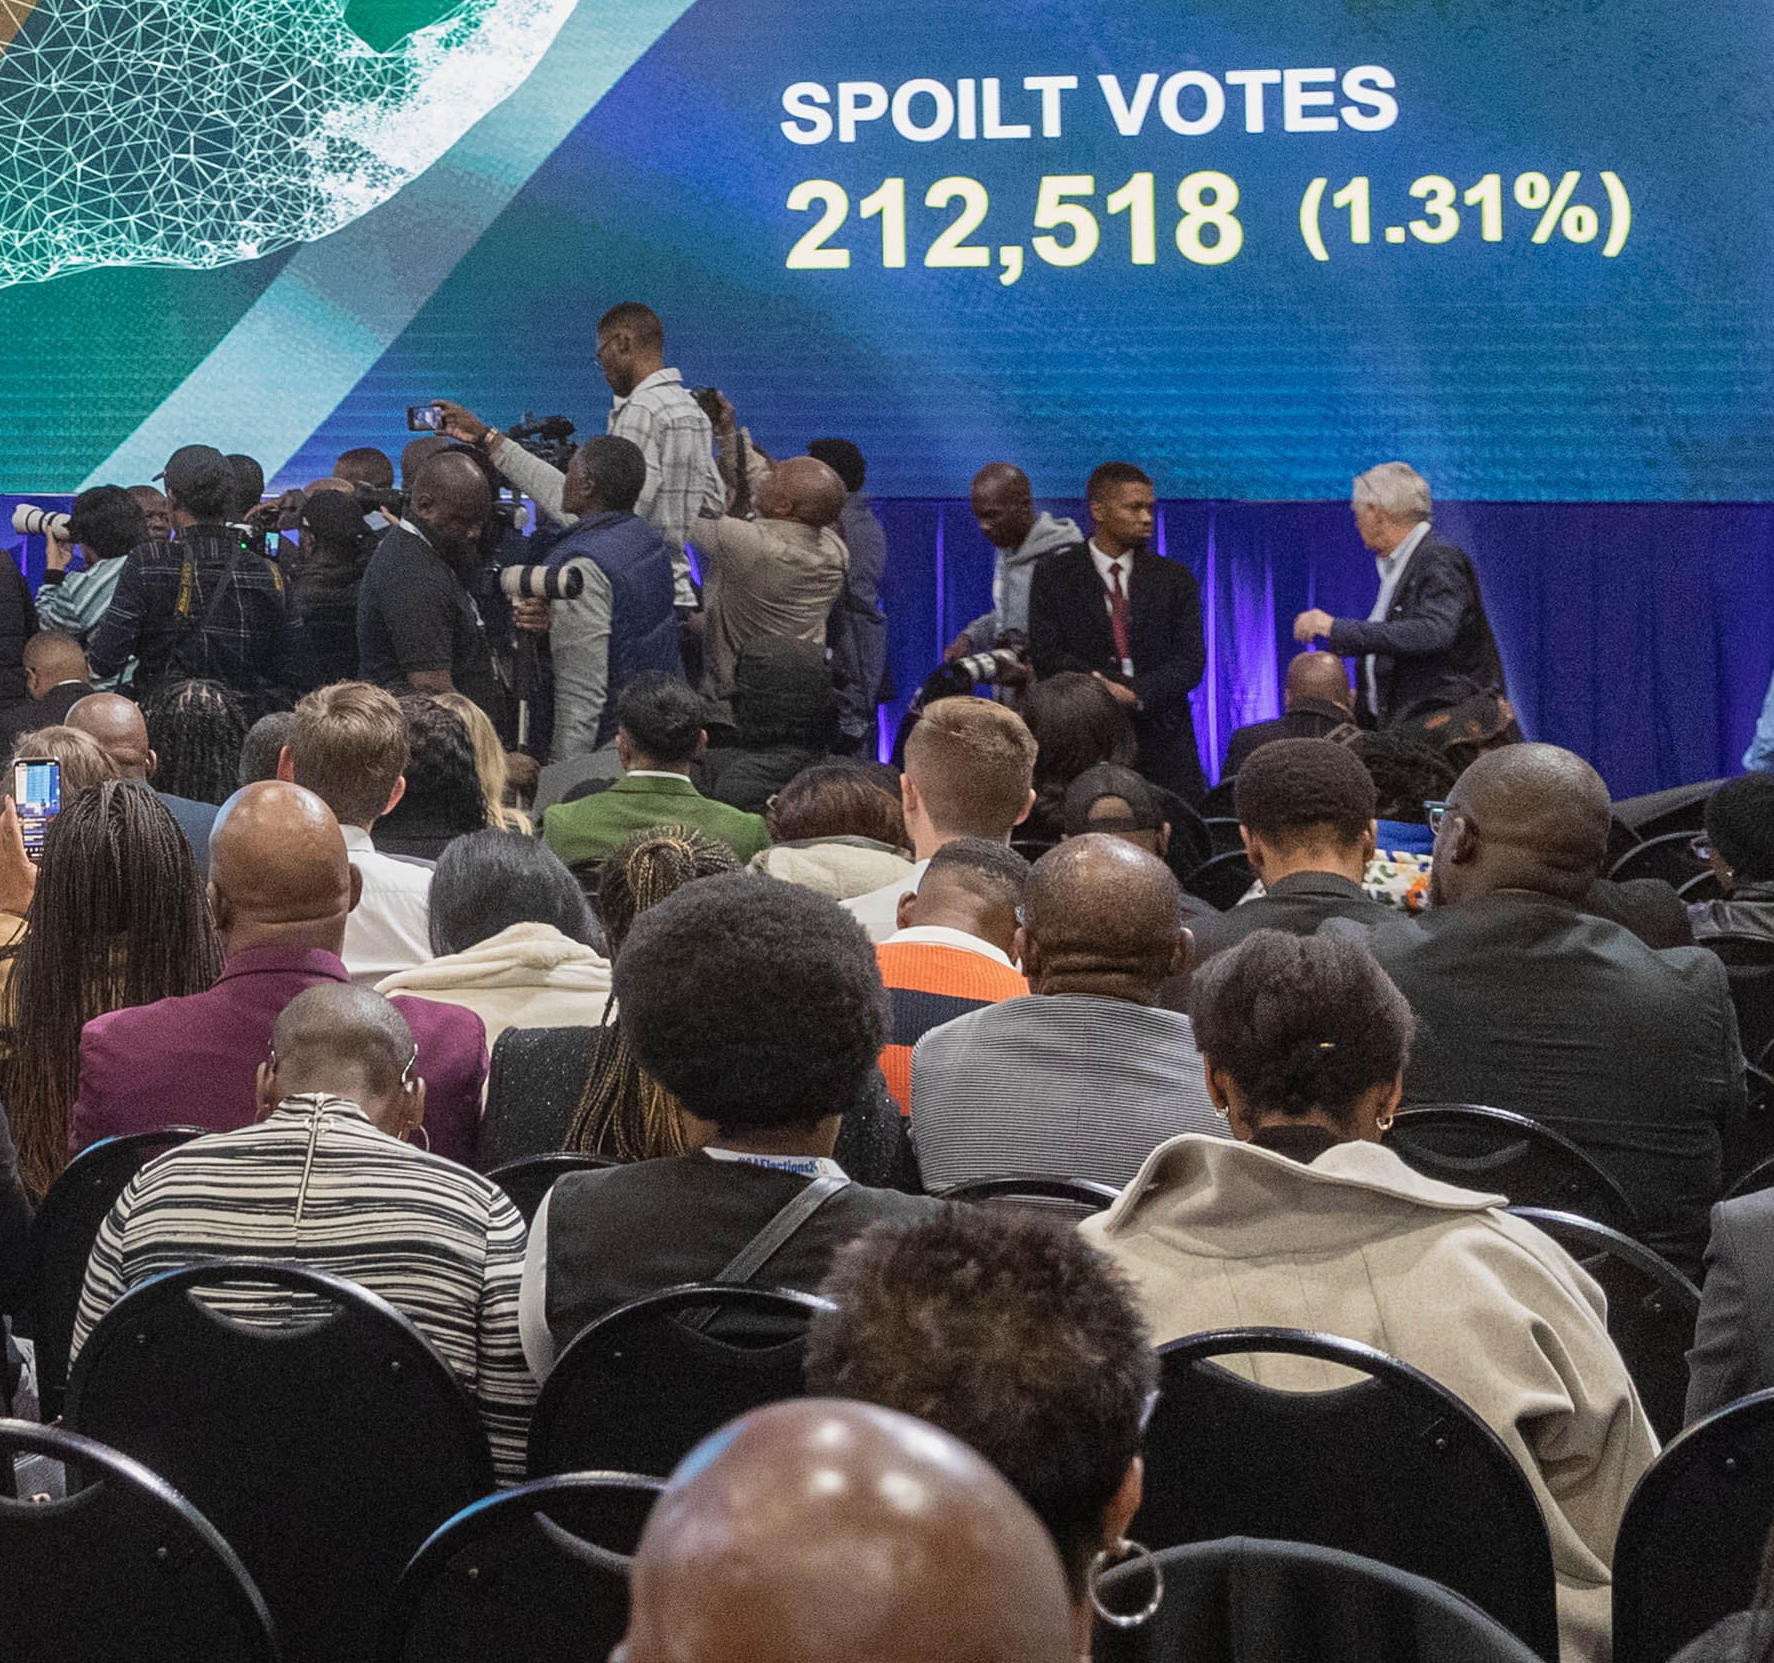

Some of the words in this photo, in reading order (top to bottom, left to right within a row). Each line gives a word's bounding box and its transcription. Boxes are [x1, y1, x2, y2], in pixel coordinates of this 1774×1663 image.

[781, 76, 1077, 144] SPOILT
[1098, 66, 1398, 135] VOTES
[786, 171, 1242, 285] 212,518
[1300, 171, 1630, 261] (1.31%)
